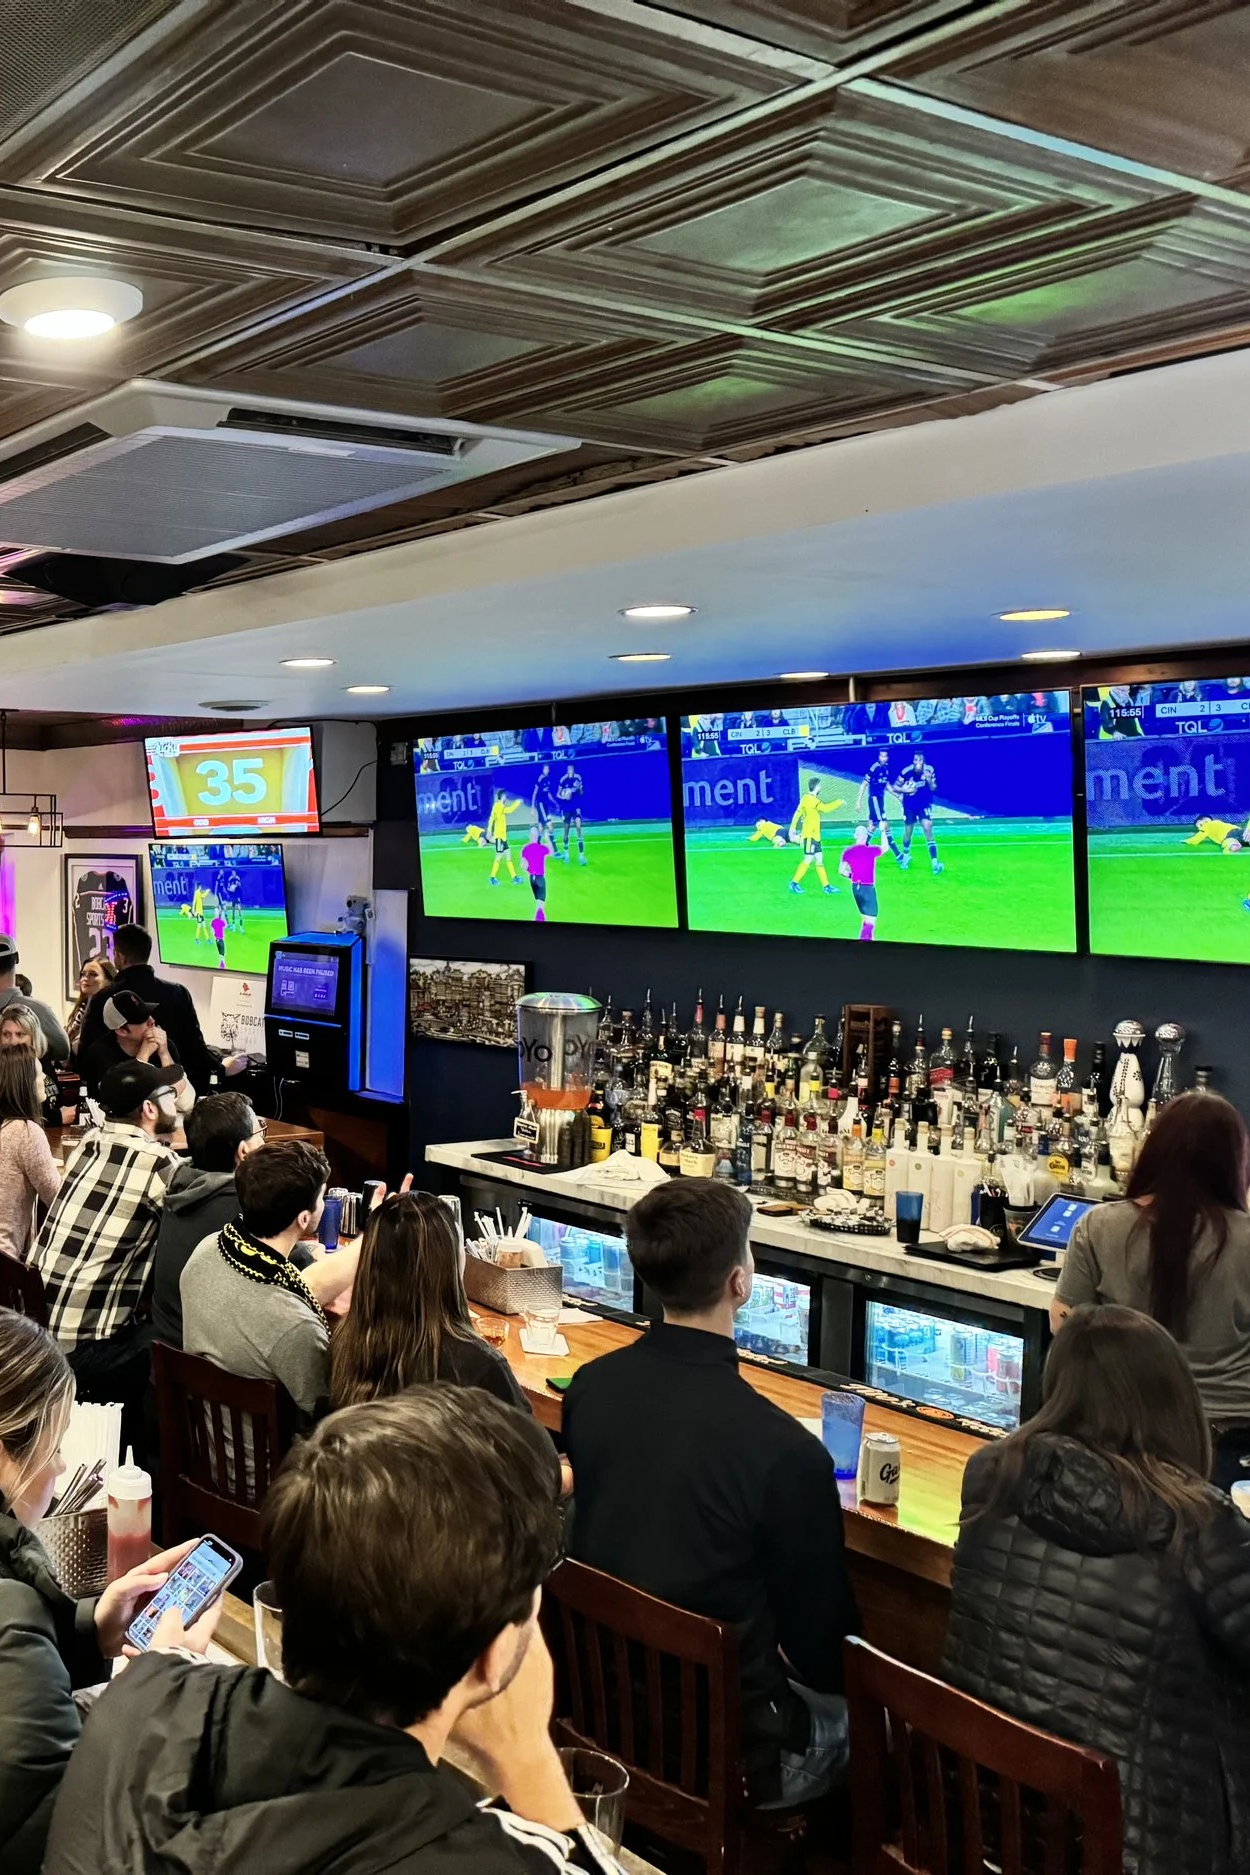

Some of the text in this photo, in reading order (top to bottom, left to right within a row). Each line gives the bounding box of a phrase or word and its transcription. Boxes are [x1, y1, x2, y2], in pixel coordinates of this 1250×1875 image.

[1110, 708, 1142, 718] 115:55
[1160, 706, 1177, 714] CIN
[1200, 704, 1206, 712] 2
[1215, 703, 1222, 711] 3
[730, 730, 742, 738] CIN
[782, 727, 796, 736] CLB
[1175, 721, 1207, 734] TQL
[886, 733, 910, 744] TQL
[739, 743, 761, 755] TQL
[195, 757, 267, 806] 35
[1086, 754, 1226, 800] ment
[683, 768, 774, 808] ment
[418, 782, 479, 814] ment
[153, 875, 187, 896] ment
